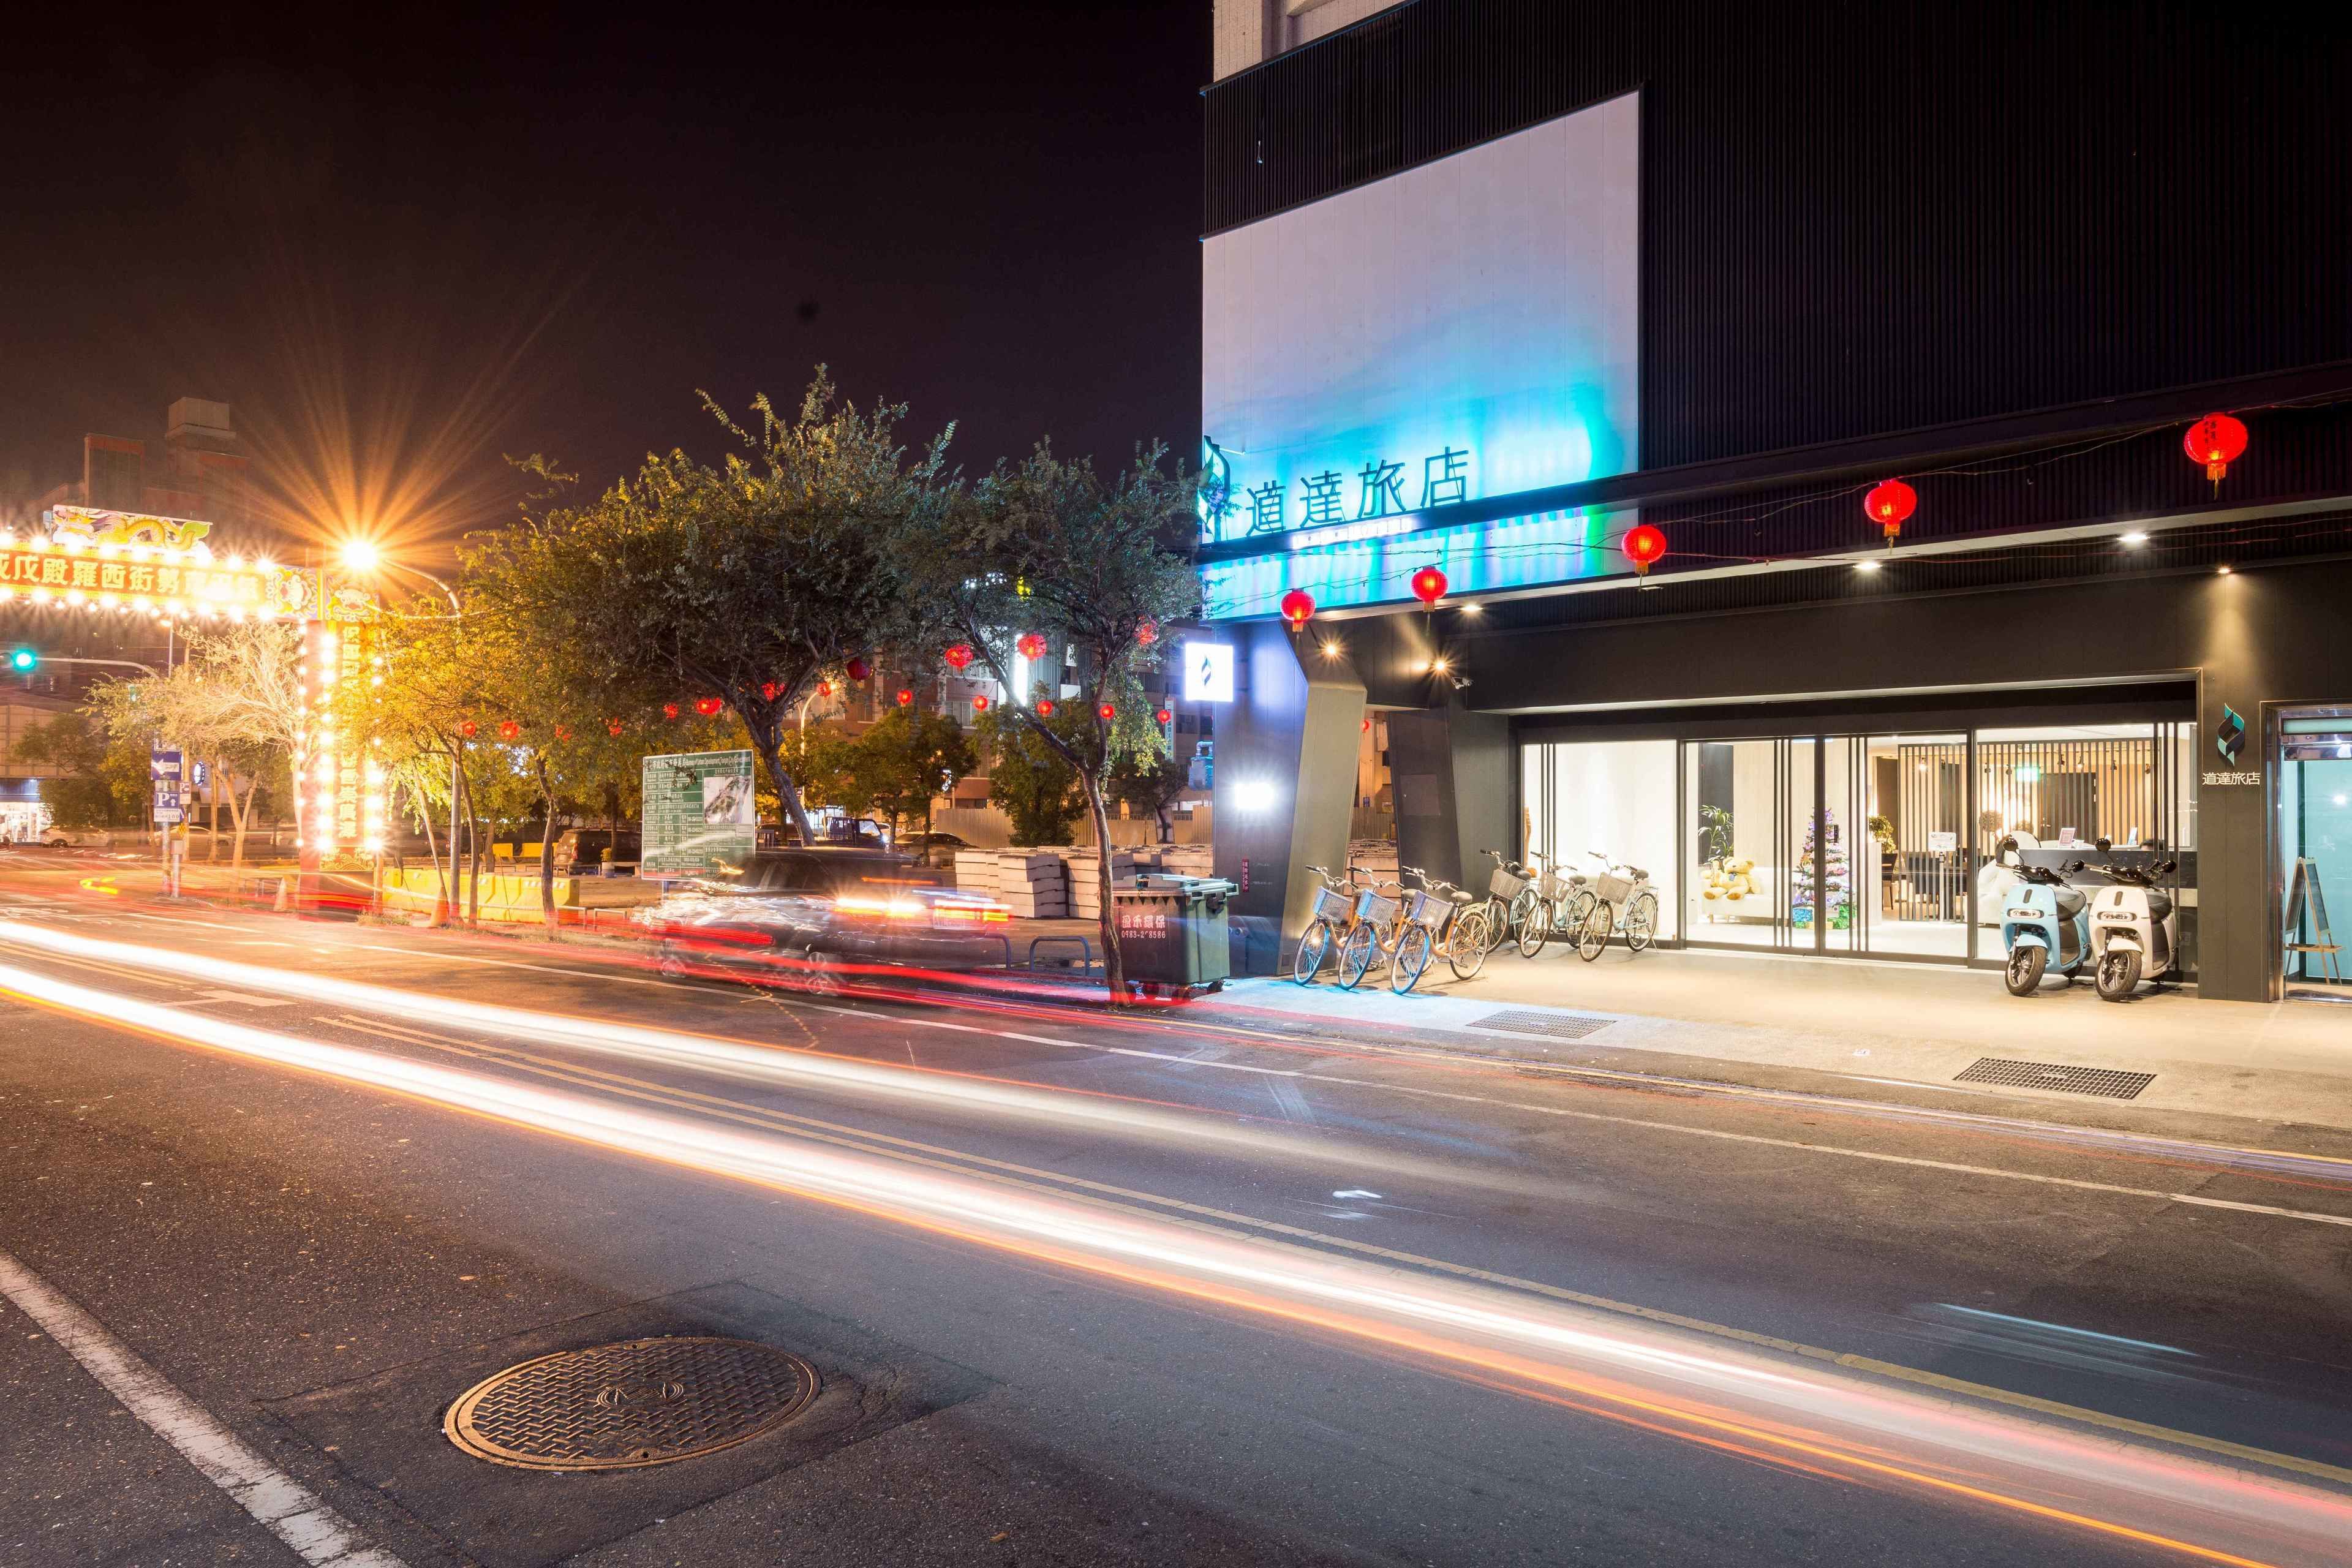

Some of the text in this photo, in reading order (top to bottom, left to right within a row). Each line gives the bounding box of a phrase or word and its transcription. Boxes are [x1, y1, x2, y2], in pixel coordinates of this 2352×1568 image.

[1245, 446, 1469, 538] 道達旅店
[2202, 772, 2261, 785] 道達旅店
[156, 793, 170, 807] P
